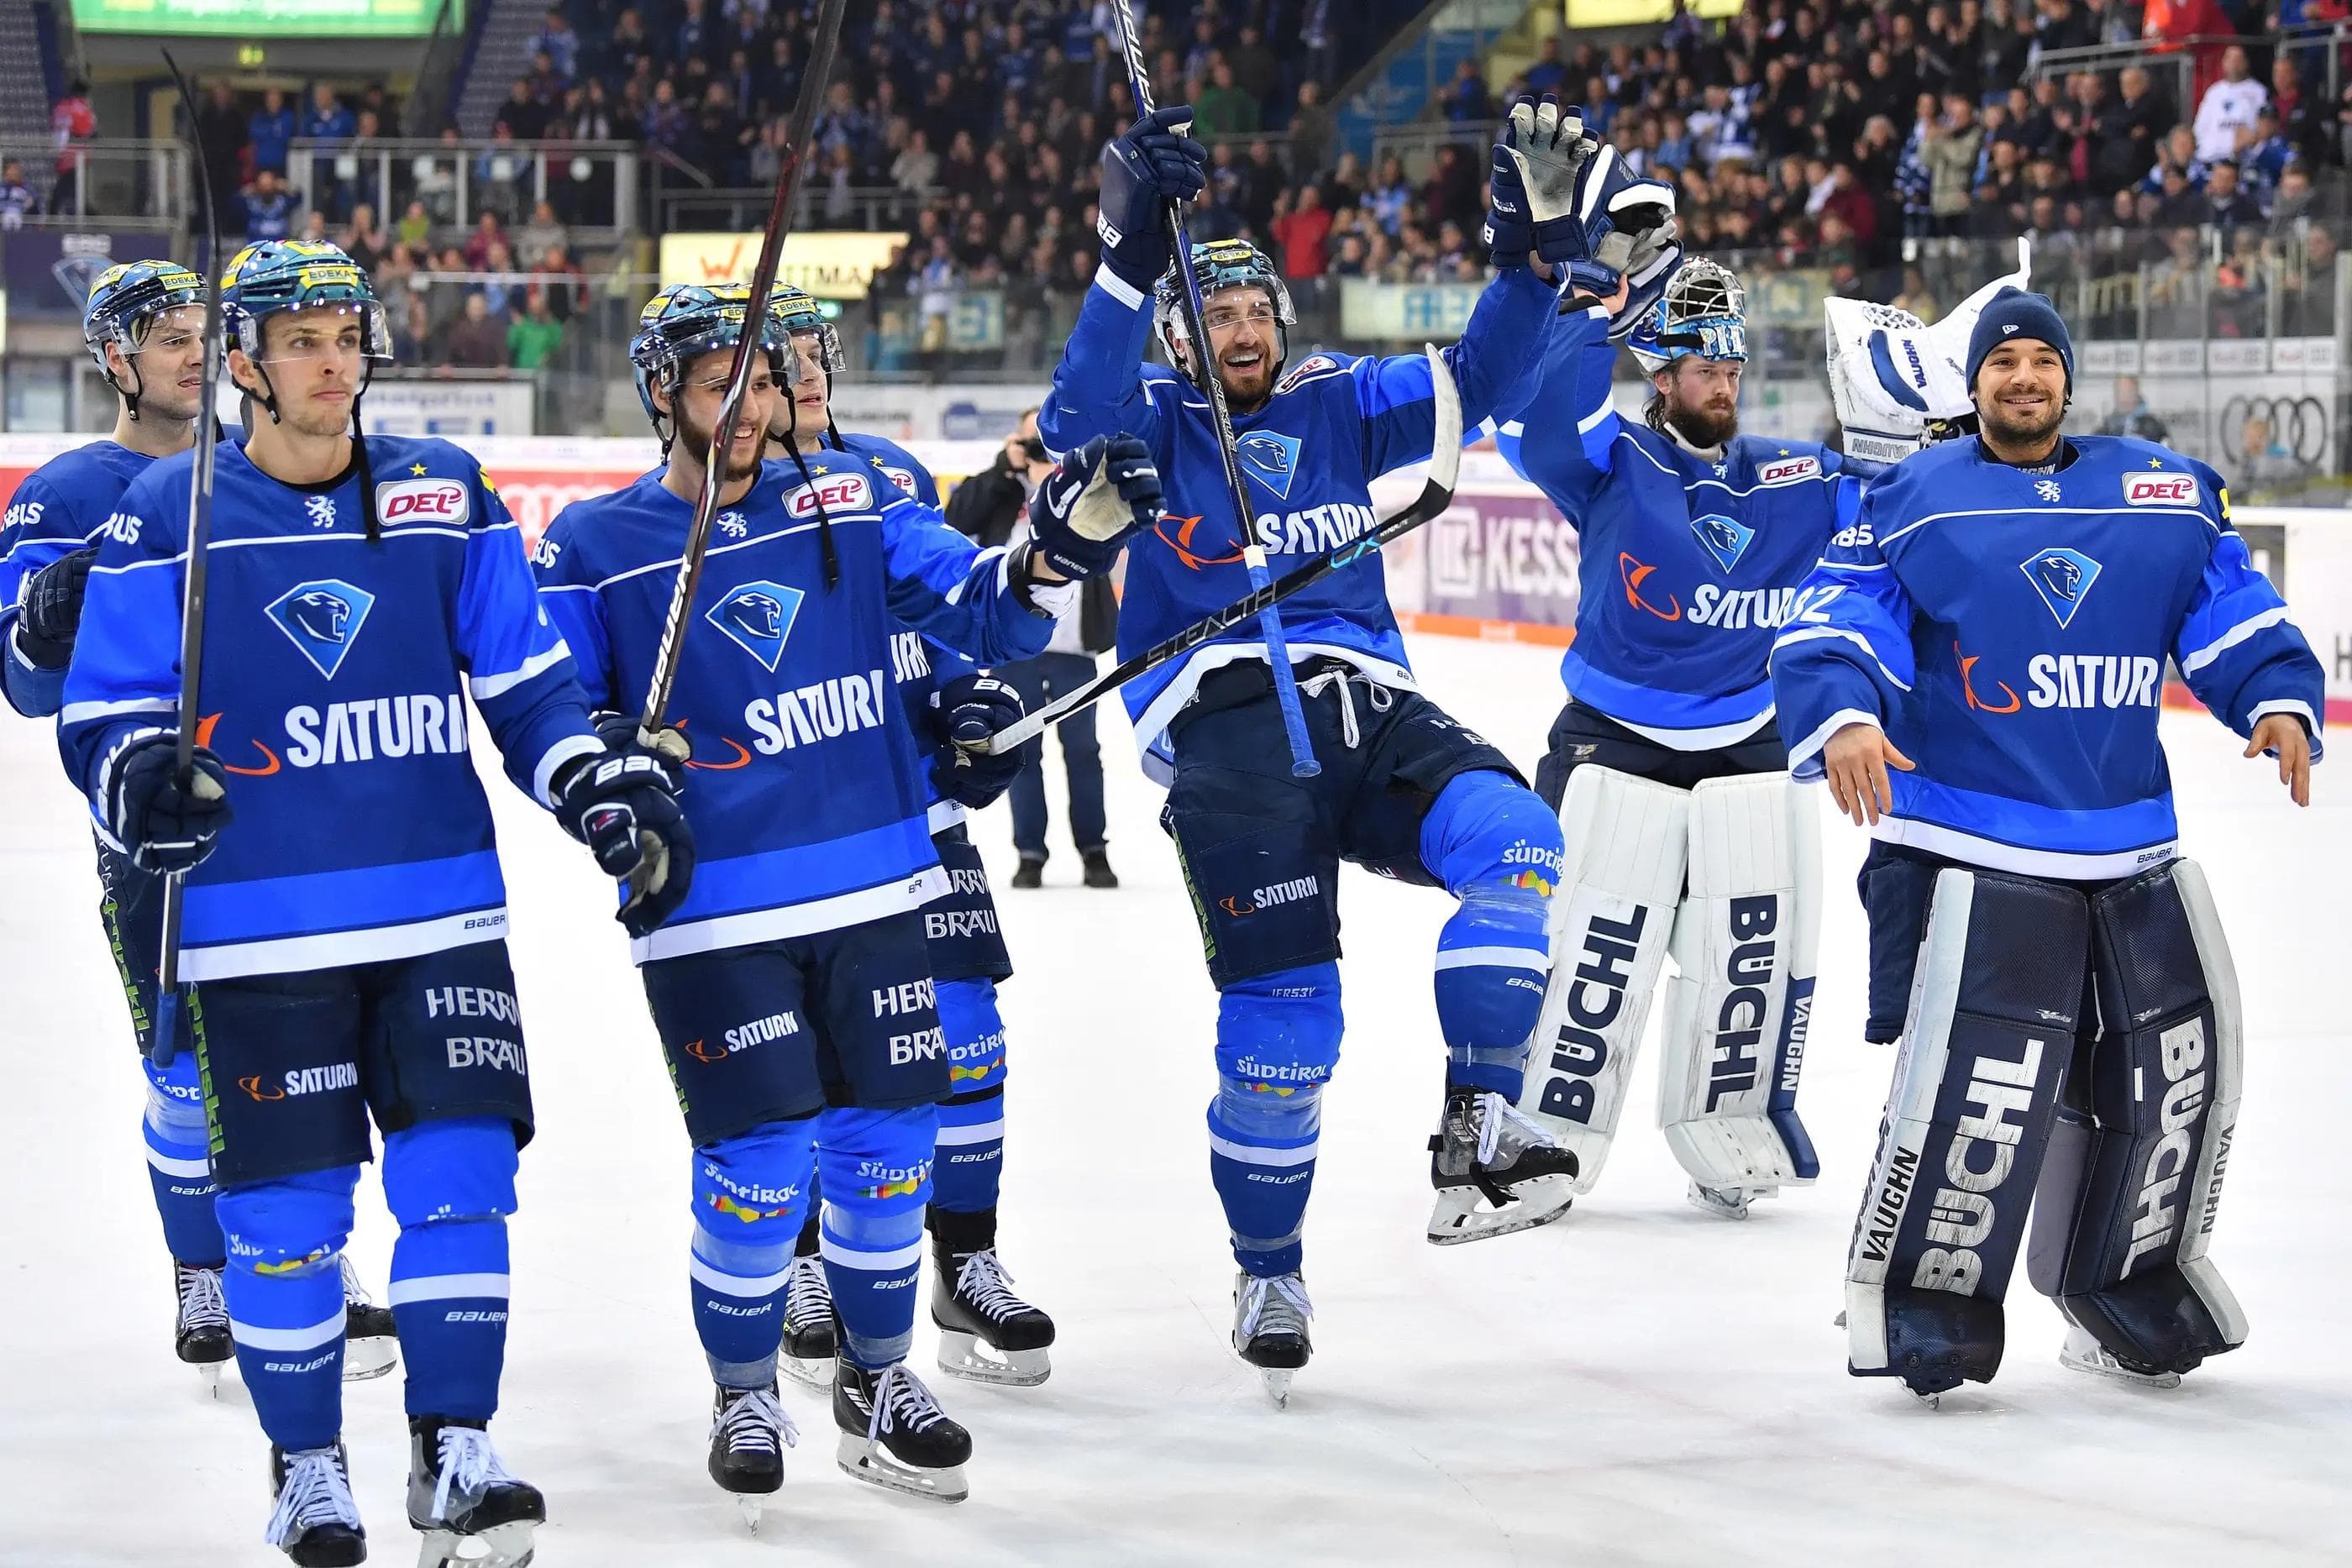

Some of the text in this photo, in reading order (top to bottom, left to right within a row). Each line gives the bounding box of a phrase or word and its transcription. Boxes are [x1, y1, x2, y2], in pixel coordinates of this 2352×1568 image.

[164, 275, 198, 287] EDEKA
[307, 269, 351, 281] EDEKA
[780, 300, 811, 312] EDEKA
[1901, 338, 1928, 389] VAUGHN
[1211, 378, 1237, 453] NEXUS
[1851, 437, 1910, 459] VAUGHN
[1765, 459, 1816, 480] DEL
[386, 485, 462, 520] DEL
[797, 478, 863, 513] DEL
[2131, 477, 2195, 501] DEL
[1053, 553, 1089, 575] BAUER
[646, 553, 691, 716] BAUER
[1144, 580, 1279, 669] STEALTH
[2027, 653, 2160, 709] SATUR
[2137, 847, 2172, 865] BAUER
[1255, 874, 1319, 909] SATURN
[464, 915, 507, 931] BAUER
[1538, 904, 1649, 1125] BÜCHL
[1705, 893, 1778, 1114] BÜCHL
[724, 1011, 799, 1053] SATURN
[1780, 994, 1814, 1093] VAUGHN
[446, 1036, 526, 1077] BRÄU
[285, 1061, 359, 1096] SATURN
[950, 1146, 1003, 1165] BAUER
[2118, 1015, 2204, 1282] BÜCHL
[1247, 1169, 1309, 1186] BAUER
[1911, 1038, 2045, 1298] BÜCHL
[2200, 1122, 2236, 1235] VAUGHN
[1861, 1145, 1919, 1262] VAUGHN
[444, 1309, 507, 1324] BAUER
[706, 1299, 773, 1318] BAUER
[264, 1351, 335, 1372] BAUER
